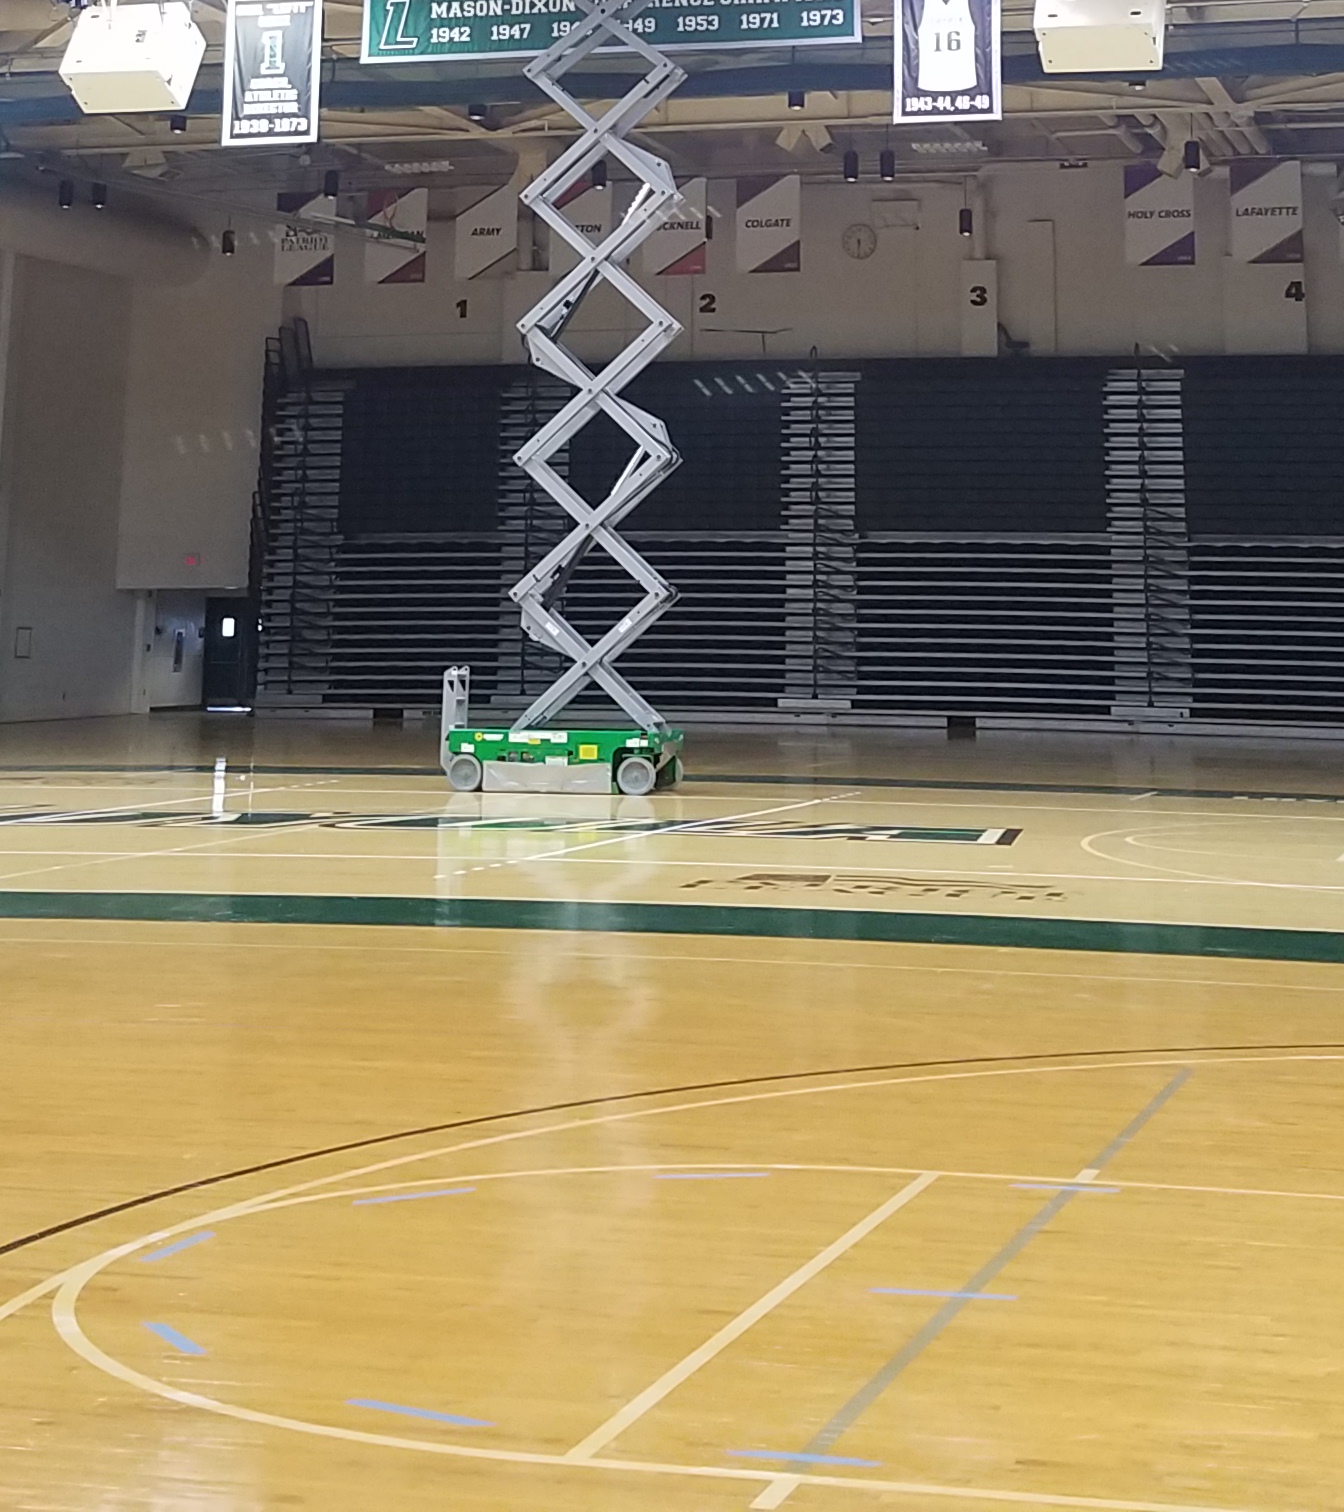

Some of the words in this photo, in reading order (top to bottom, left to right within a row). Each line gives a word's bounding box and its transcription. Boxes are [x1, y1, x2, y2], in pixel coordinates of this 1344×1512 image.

[430, 26, 471, 43] 1942
[490, 23, 531, 40] 1947
[677, 15, 719, 32] 1953
[740, 12, 779, 29] 1971
[801, 9, 844, 27] 1973
[934, 30, 961, 52] 16
[260, 30, 285, 75] 1
[1127, 209, 1155, 220] HOLY
[1158, 208, 1192, 219] CROSS
[1236, 206, 1299, 217] LAFAYETTE
[471, 227, 502, 236] ARMY
[745, 218, 791, 229] COLGATE
[969, 286, 988, 306] 3
[1284, 281, 1305, 302] 4
[456, 299, 468, 319] 1
[699, 293, 716, 313] 2
